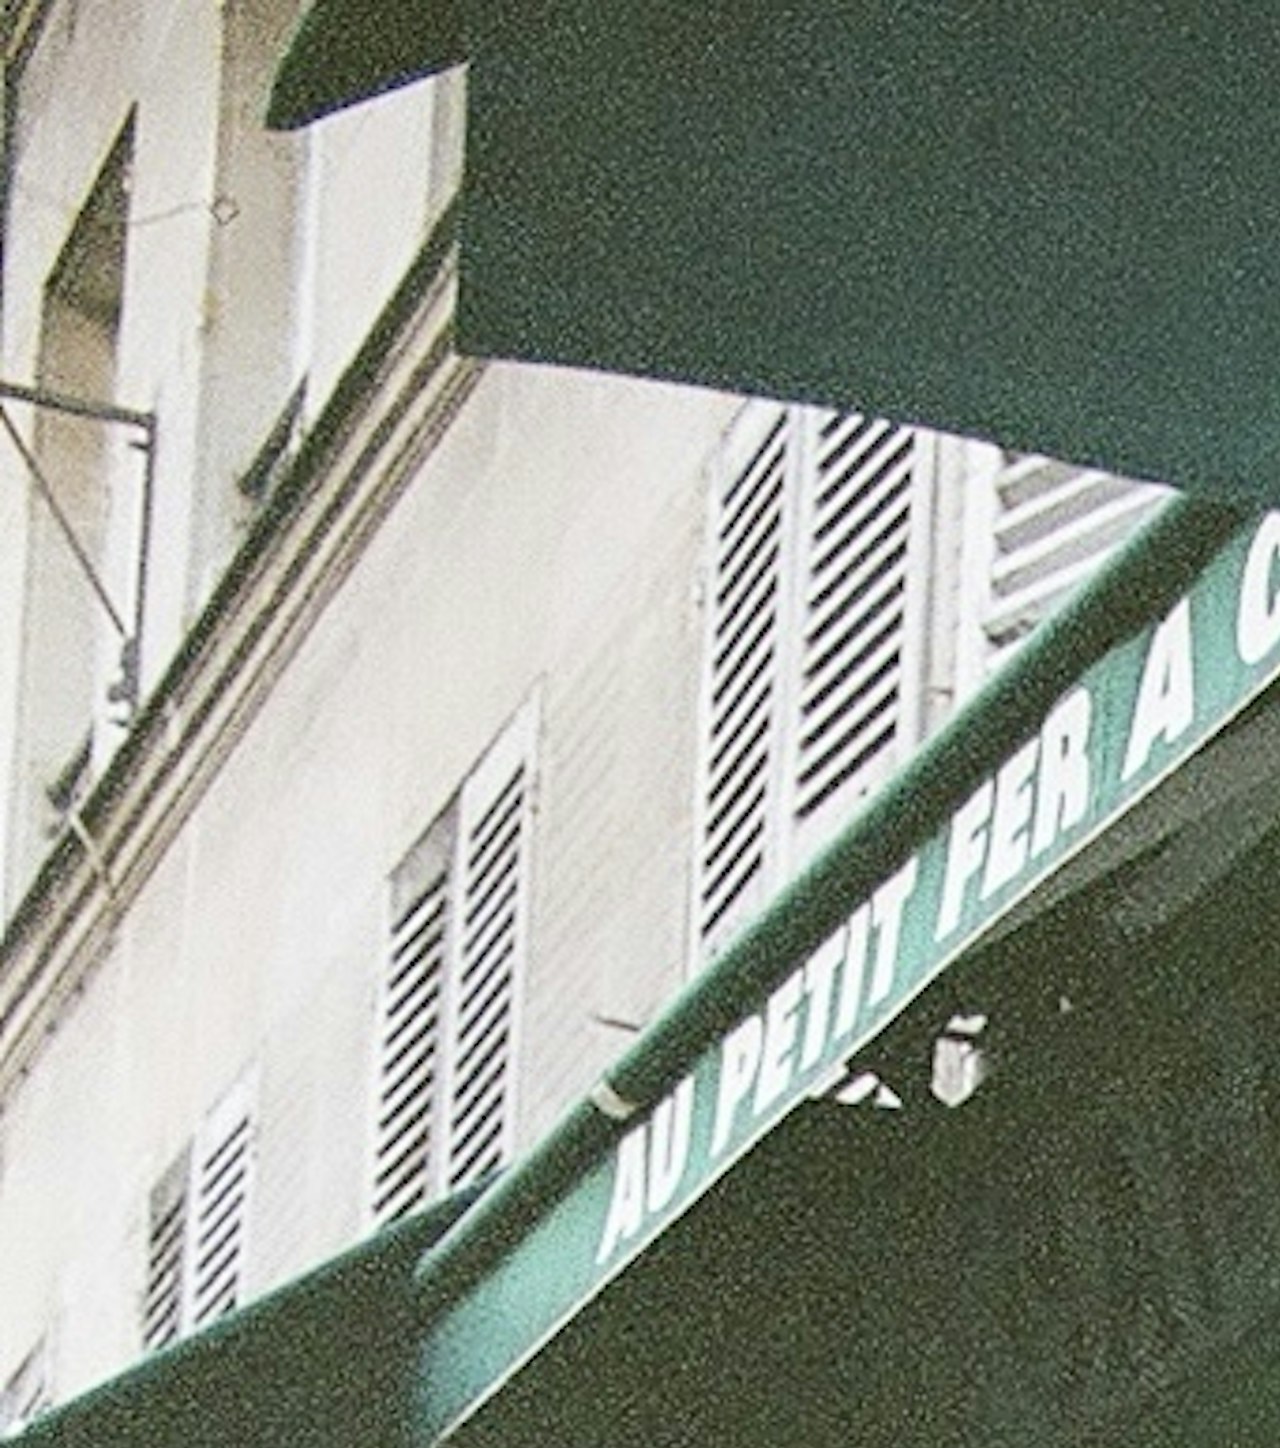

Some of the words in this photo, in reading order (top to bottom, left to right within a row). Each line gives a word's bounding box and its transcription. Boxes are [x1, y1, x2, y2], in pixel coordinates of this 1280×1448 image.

[594, 1074, 694, 1265] AU
[709, 854, 921, 1160] PETIT
[933, 684, 1093, 943] FER
[1120, 594, 1195, 781] A
